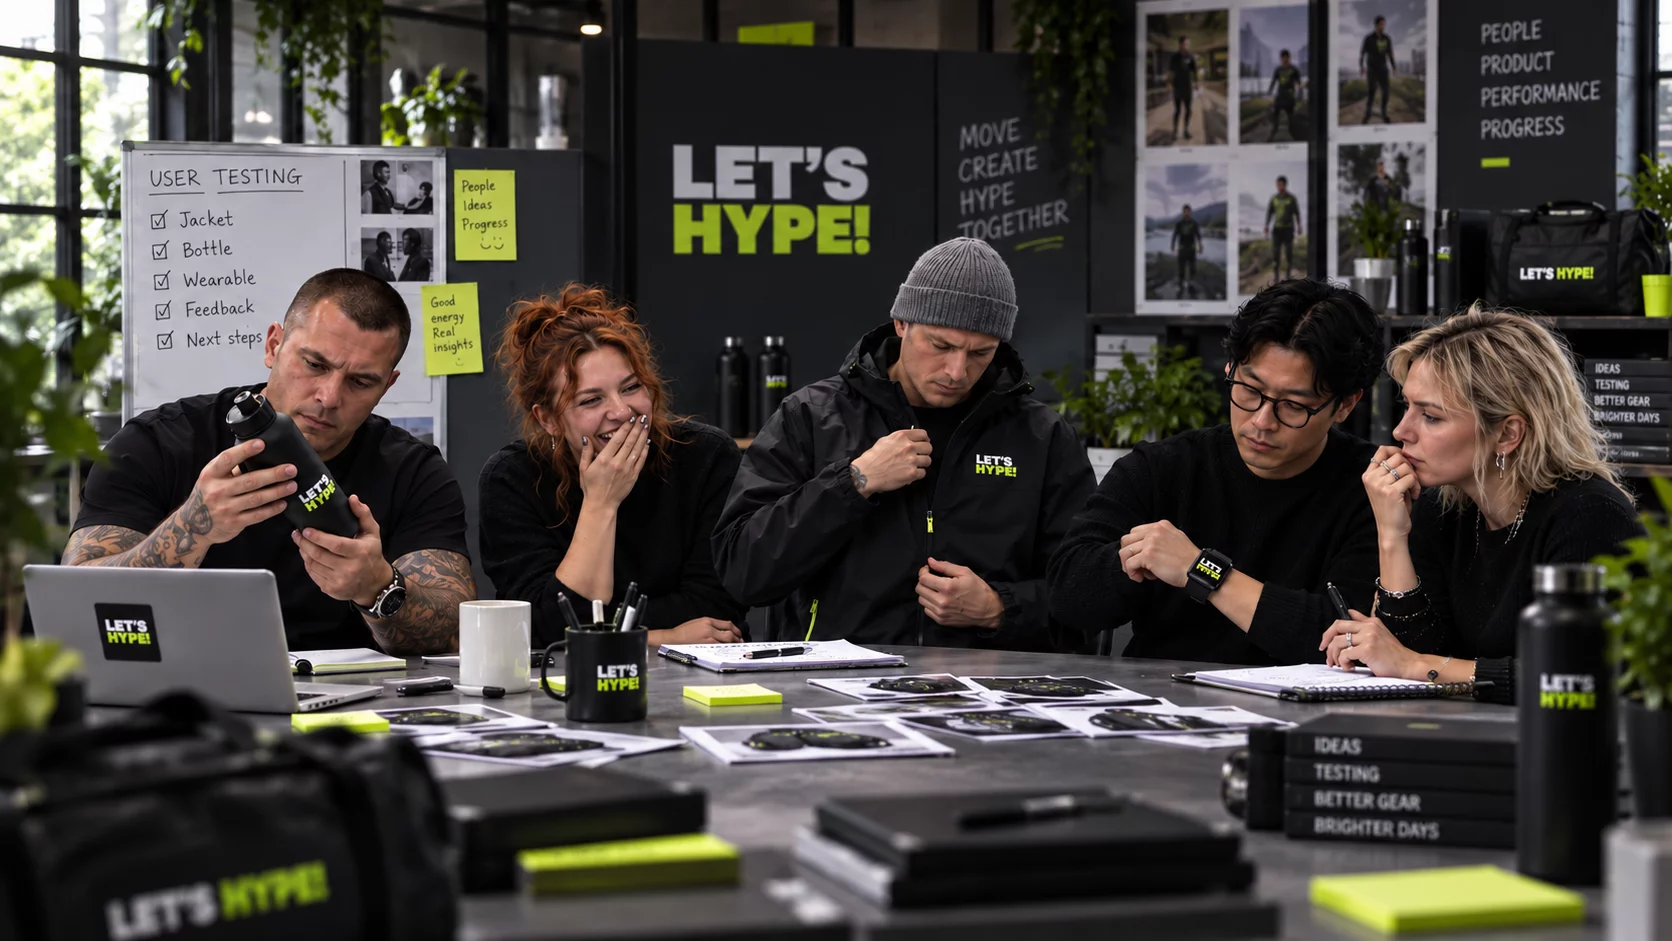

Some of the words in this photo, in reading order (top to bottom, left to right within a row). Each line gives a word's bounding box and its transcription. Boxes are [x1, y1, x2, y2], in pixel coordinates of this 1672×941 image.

[1481, 19, 1543, 45] PEOPLE
[1481, 51, 1555, 75] PRODUCT
[1481, 80, 1601, 108] PERFORMANCE
[959, 117, 1021, 151] MOVE
[1481, 115, 1565, 140] PROGRESS
[673, 144, 869, 202] LET'S
[958, 146, 1039, 183] CREATE
[150, 169, 201, 187] USER
[213, 167, 303, 185] TESTING
[462, 180, 496, 196] People
[463, 198, 493, 211] Ideas
[960, 181, 1015, 217] HYPE
[179, 210, 234, 229] Jacket
[462, 217, 508, 233] Progress
[957, 198, 1070, 240] TOGETHER
[673, 204, 871, 255] HYPE!
[183, 240, 233, 258] Bottle
[183, 271, 257, 288] Wearable
[1519, 267, 1554, 281] LET'S
[1556, 266, 1594, 280] HYPE!
[185, 300, 255, 318] Feedback
[430, 296, 456, 308] Good
[430, 312, 465, 327] energy
[186, 332, 221, 348] Next
[228, 331, 263, 350] steps
[432, 326, 456, 339] Real
[433, 338, 474, 354] insights
[1595, 363, 1621, 374] IDEAS
[1595, 379, 1630, 390] TESTING
[1594, 395, 1625, 406] BETTER
[1627, 396, 1651, 407] GEAR
[1593, 411, 1636, 422] BRIGHTER
[1637, 412, 1660, 423] DAYS
[976, 454, 1013, 467] LET'S
[976, 464, 1017, 478] HYPE!
[105, 619, 148, 633] LET'S
[107, 631, 151, 645] HYPE!
[597, 664, 638, 680] LET'S
[597, 677, 640, 693] HYPE!
[1540, 673, 1595, 692] LET'S
[1314, 737, 1362, 755] IDEAS
[1314, 763, 1380, 784] TESTING
[1314, 790, 1375, 810] BETTER
[1378, 793, 1421, 812] GEAR
[1314, 816, 1396, 838] BRIGHTER
[1398, 821, 1440, 840] DAYS
[107, 881, 217, 940] LET'S
[219, 862, 329, 920] HYPE!
